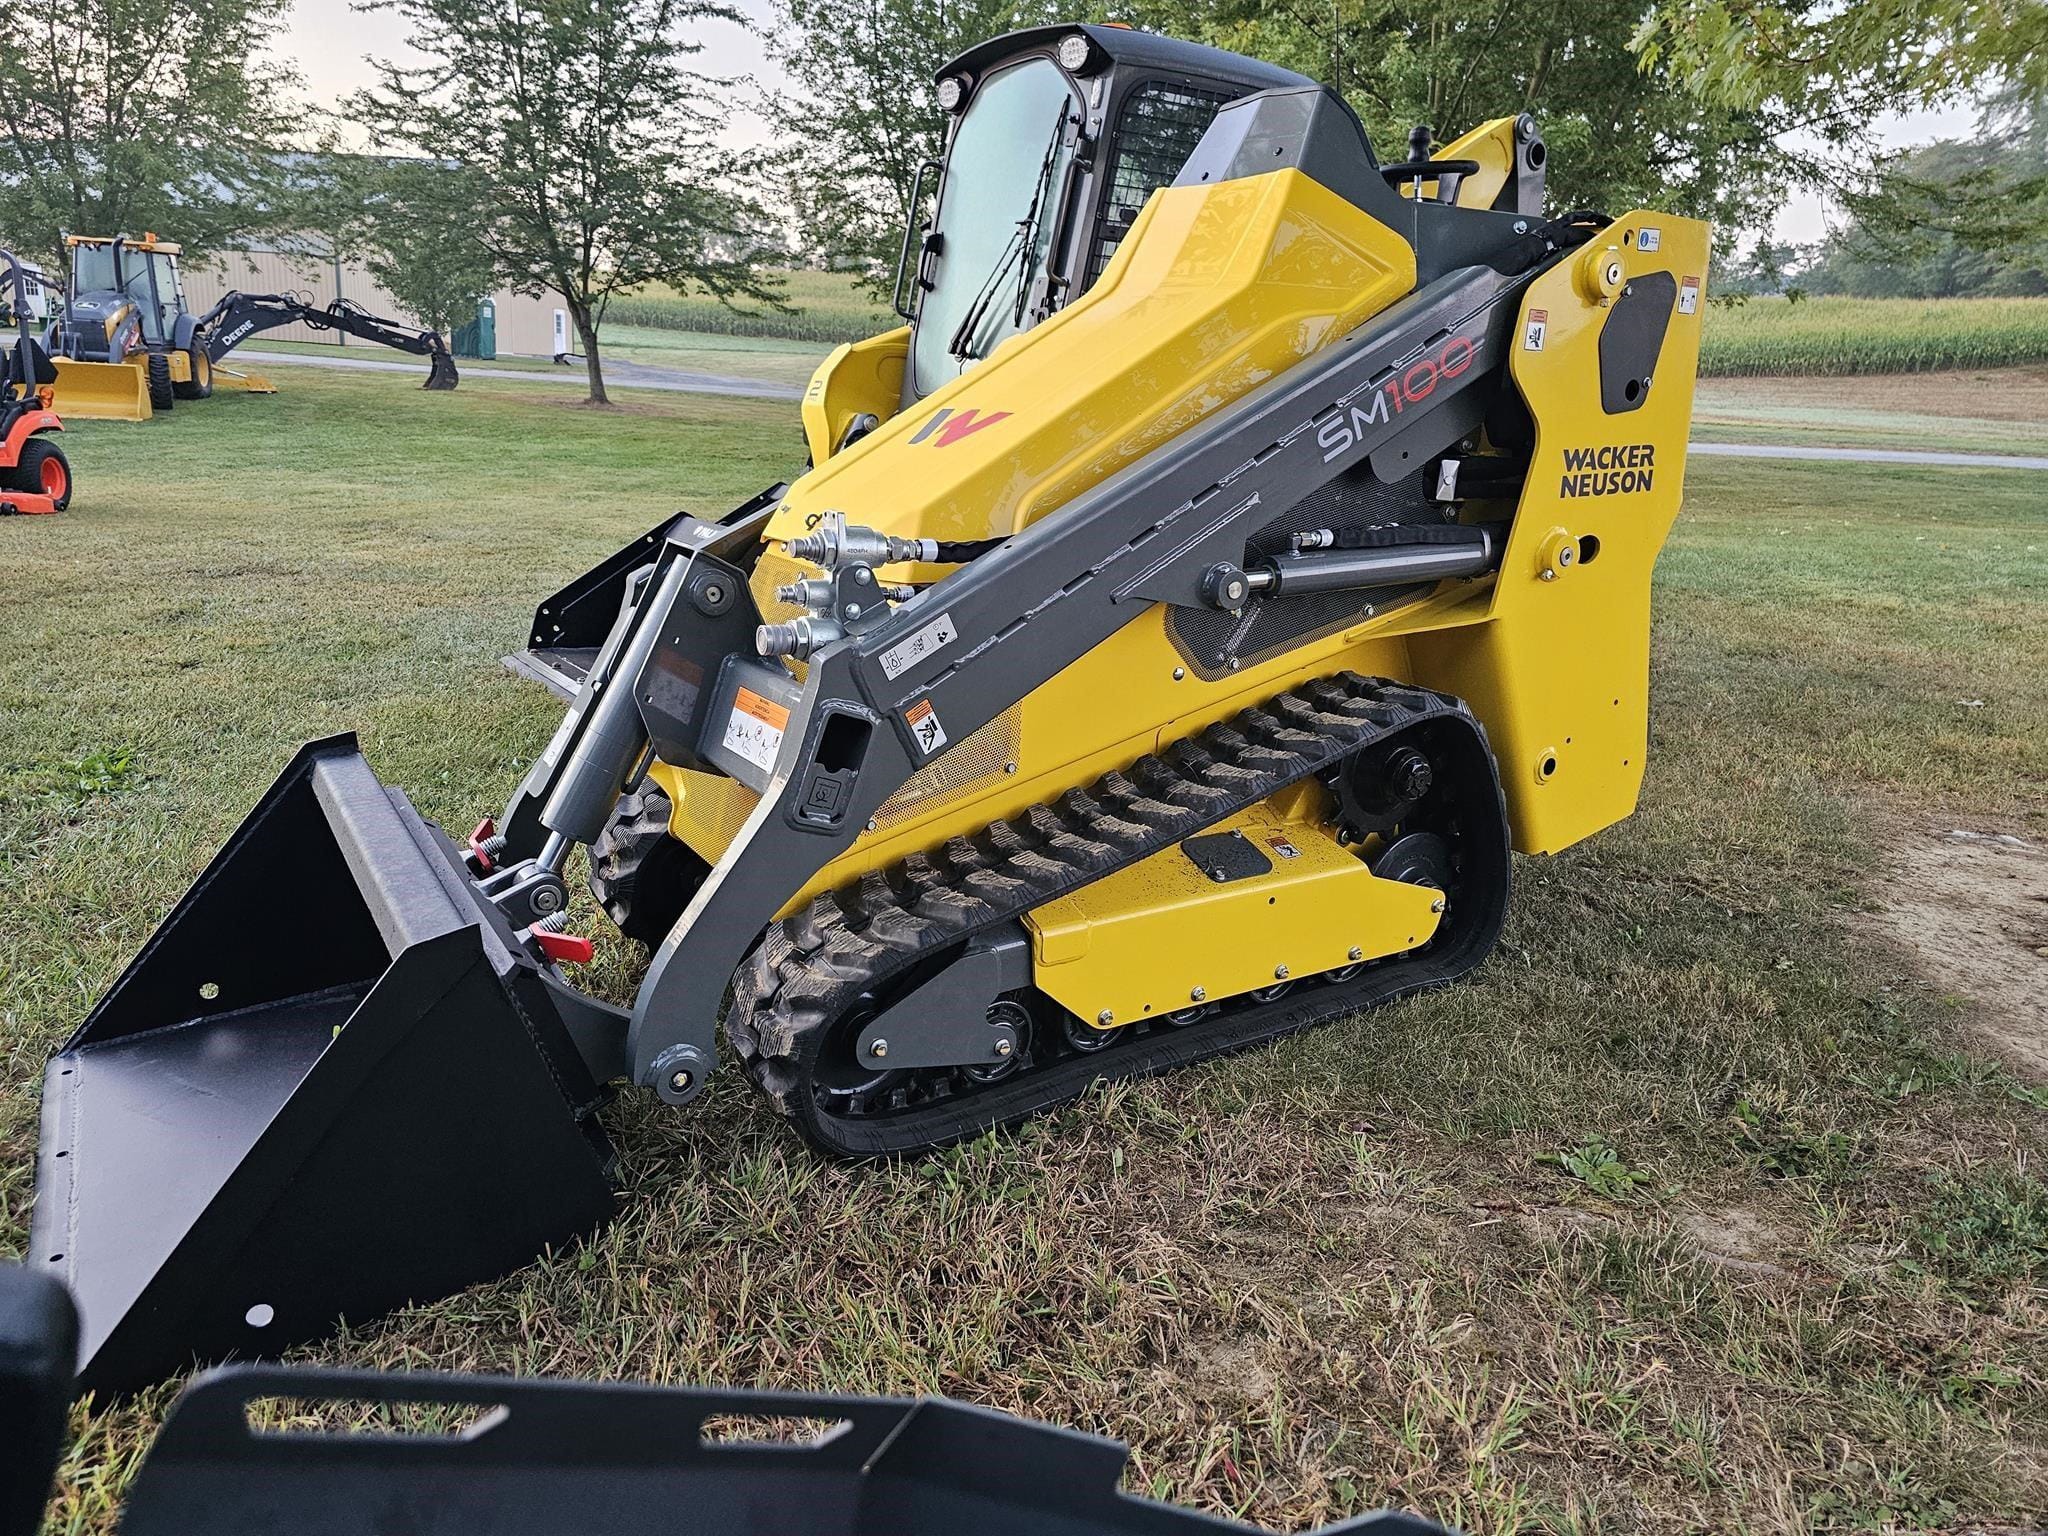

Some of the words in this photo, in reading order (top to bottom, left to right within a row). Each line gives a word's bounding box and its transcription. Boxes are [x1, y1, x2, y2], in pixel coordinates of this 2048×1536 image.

[221, 319, 255, 346] DEERE
[1317, 336, 1473, 463] SM100
[1563, 444, 1655, 472] WACKER
[1560, 469, 1653, 498] NEUSON
